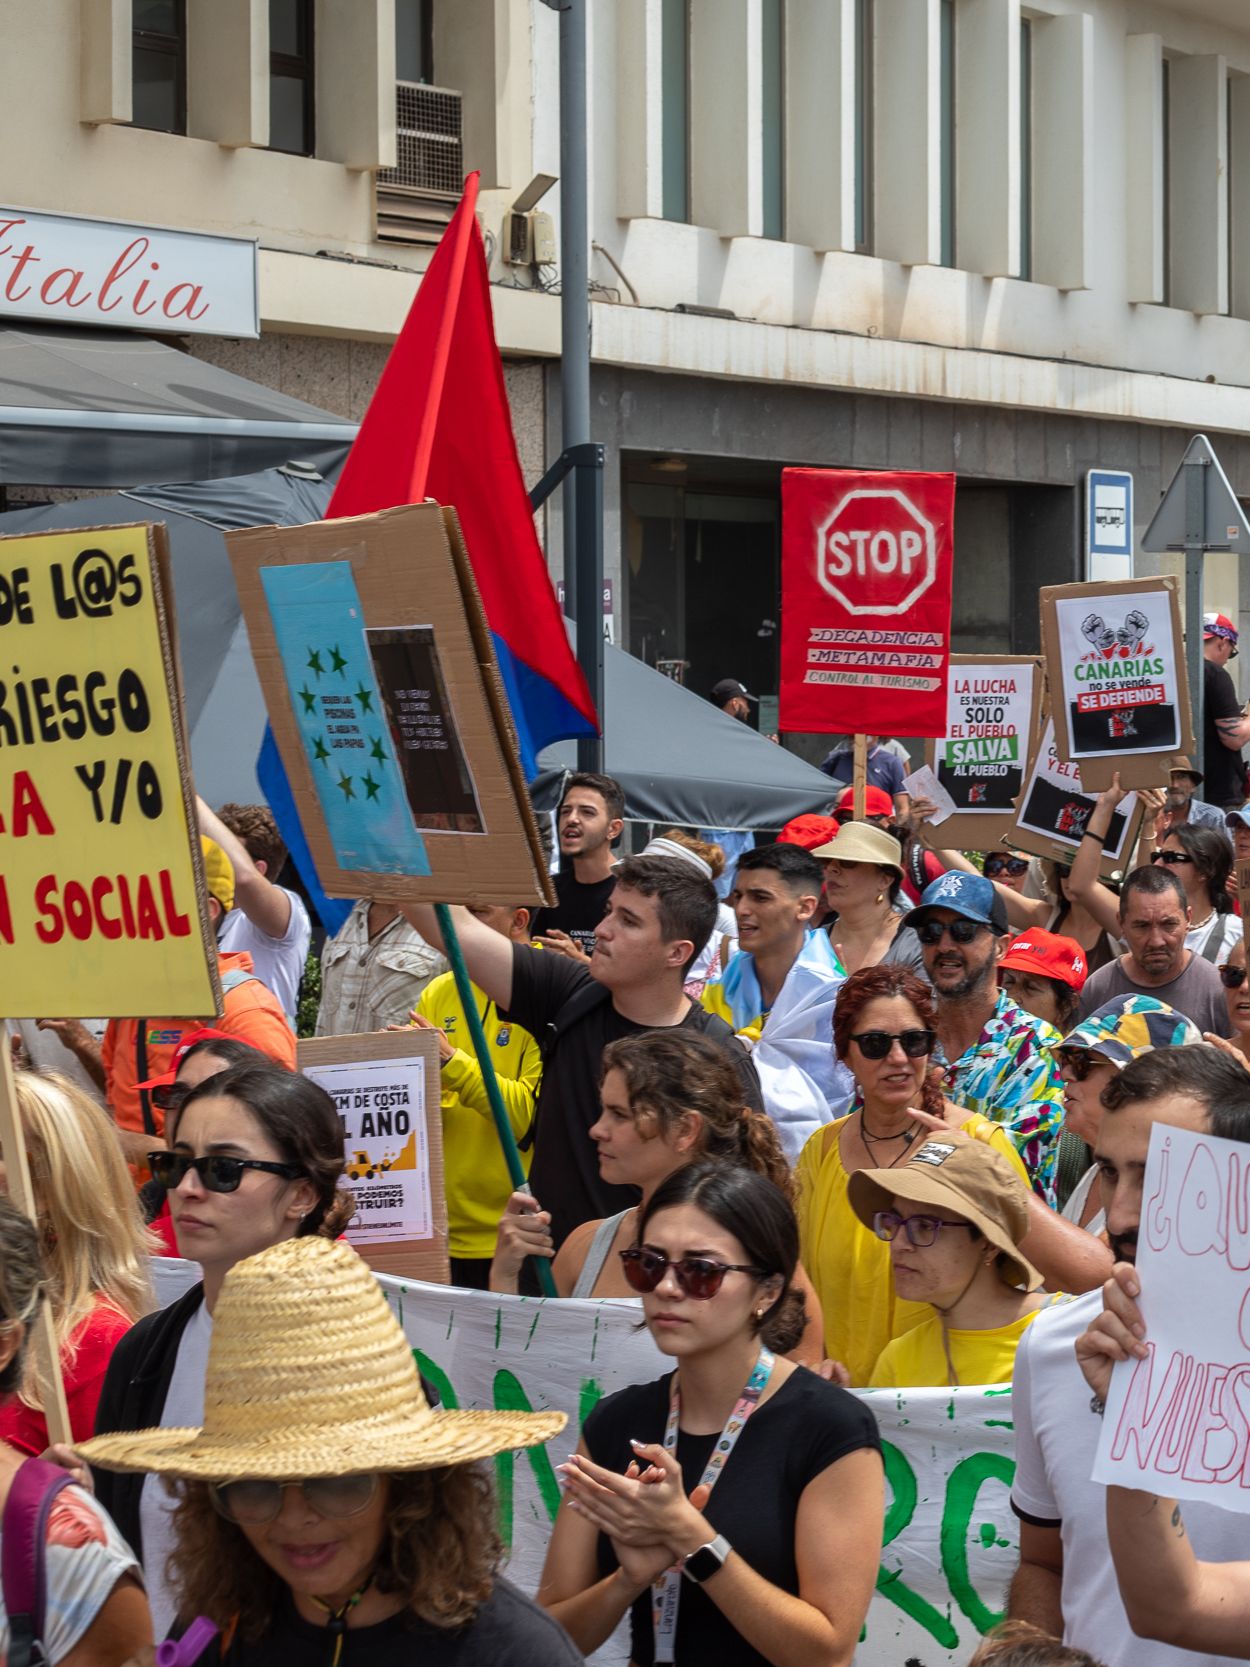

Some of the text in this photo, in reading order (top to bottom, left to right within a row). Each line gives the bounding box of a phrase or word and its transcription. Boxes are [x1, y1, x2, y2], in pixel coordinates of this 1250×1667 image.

[828, 530, 922, 576] STOP
[50, 548, 142, 620] L@S
[1074, 658, 1164, 681] CANARIAS
[809, 672, 859, 684] CONTROL
[862, 674, 875, 685] AL
[954, 679, 1016, 694] LA LUCHA
[1089, 677, 1151, 691] no se vende
[960, 696, 1010, 705] ES NUESTRA
[1081, 687, 1163, 709] SE DEFIENDE
[965, 708, 1004, 723] SOLO
[951, 725, 1016, 738] EL PUEBLO
[952, 738, 1012, 763] SALVA
[953, 765, 1008, 776] AL PUEBLO
[1048, 760, 1056, 771] Y
[1057, 762, 1069, 777] EL
[75, 758, 163, 825] Y/O
[35, 869, 191, 944] SOCIAL
[355, 1092, 410, 1108] DE COSTA
[360, 1107, 410, 1138] AÑO
[357, 1190, 404, 1199] PODEMOS
